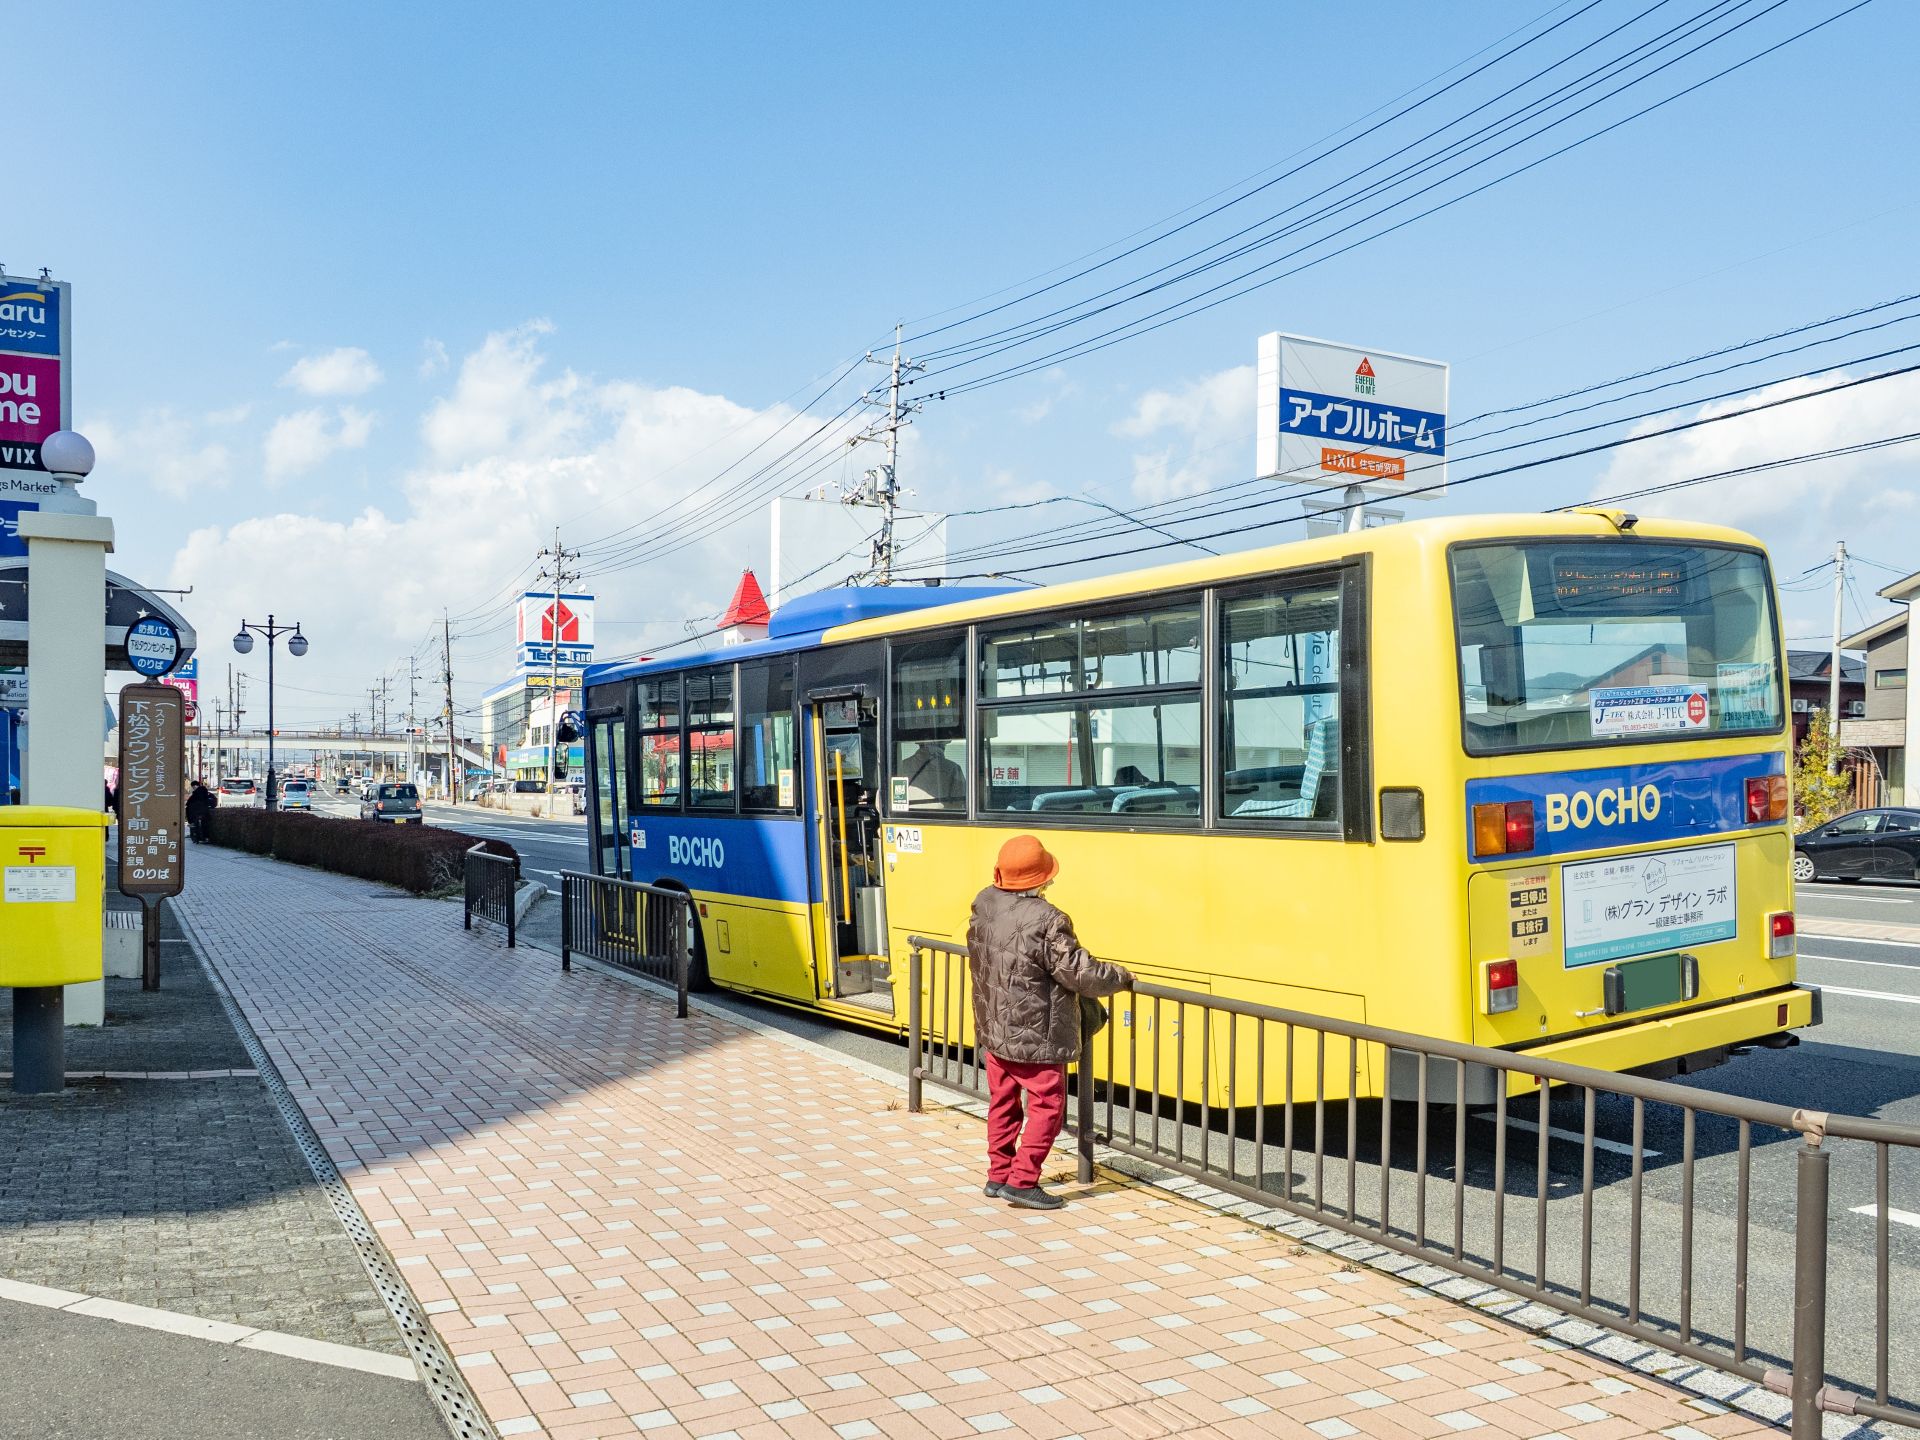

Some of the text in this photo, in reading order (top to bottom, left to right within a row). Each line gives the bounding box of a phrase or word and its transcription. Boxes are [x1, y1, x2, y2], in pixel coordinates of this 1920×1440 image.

[1355, 384, 1376, 396] HOME
[1288, 396, 1436, 449] アイフルホーム
[2, 446, 36, 465] VIX
[11, 479, 57, 494] Market
[138, 624, 170, 637] 防長バス
[137, 658, 165, 670] のりば
[1627, 709, 1655, 721] 株式会社
[1656, 706, 1685, 720] J-TEC
[127, 701, 151, 831] 下松タウンセンター前
[992, 766, 1020, 780] 店舗
[1546, 784, 1661, 832] BOCHO
[669, 835, 725, 869] BOCHO
[132, 868, 170, 880] のりば
[1511, 889, 1547, 905] 一旦停止
[1660, 892, 1701, 914] デザイン
[1706, 885, 1728, 905] ラボ
[1521, 907, 1538, 917] または
[1648, 910, 1704, 929] 一級建築士事務所
[1523, 937, 1539, 946] します
